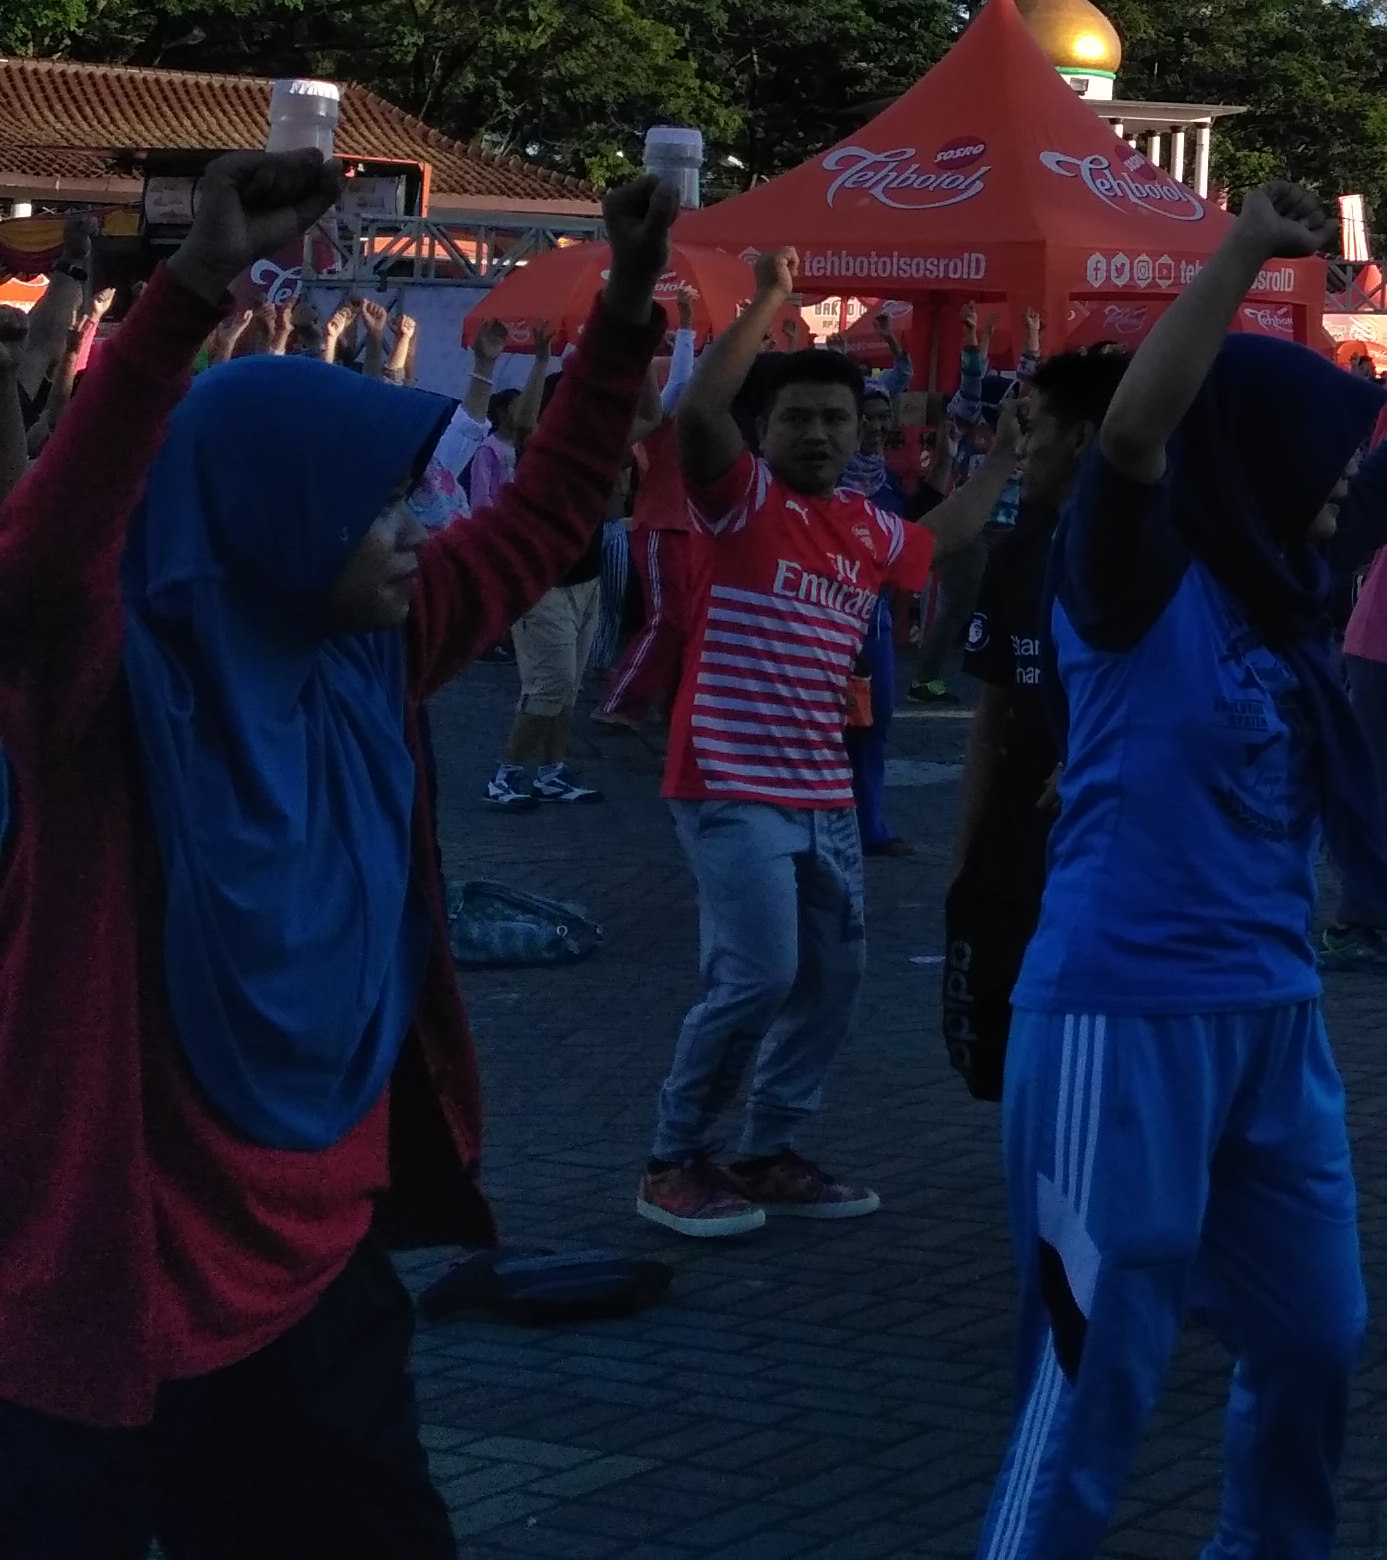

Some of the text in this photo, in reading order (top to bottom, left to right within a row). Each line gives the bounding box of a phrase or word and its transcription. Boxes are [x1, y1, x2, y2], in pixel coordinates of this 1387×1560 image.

[822, 146, 992, 209] Tehbotol
[1040, 151, 1204, 220] Tehbotol
[804, 251, 985, 280] tehbotolsosroID
[814, 300, 855, 316] BAKO
[773, 558, 879, 620] Emirate
